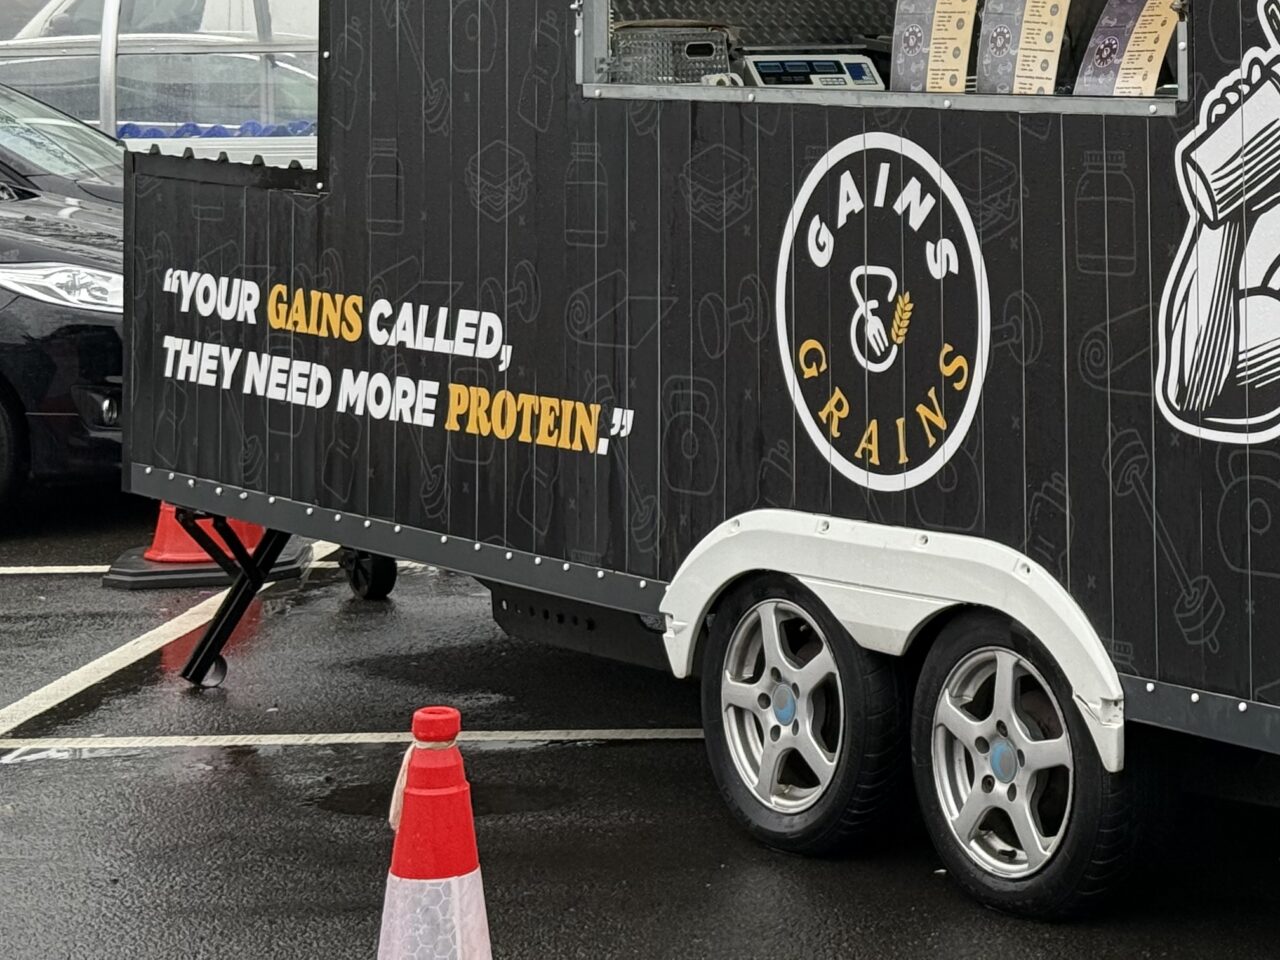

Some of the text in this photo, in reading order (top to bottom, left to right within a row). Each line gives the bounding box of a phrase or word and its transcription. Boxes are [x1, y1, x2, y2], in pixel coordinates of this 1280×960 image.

[807, 163, 959, 280] GAINS
[267, 283, 363, 342] GAINS
[368, 298, 512, 372] CALLED,
[163, 336, 242, 390] THEY
[243, 350, 332, 409] NEED
[336, 369, 440, 428] MORE
[799, 339, 969, 466] GRAINS
